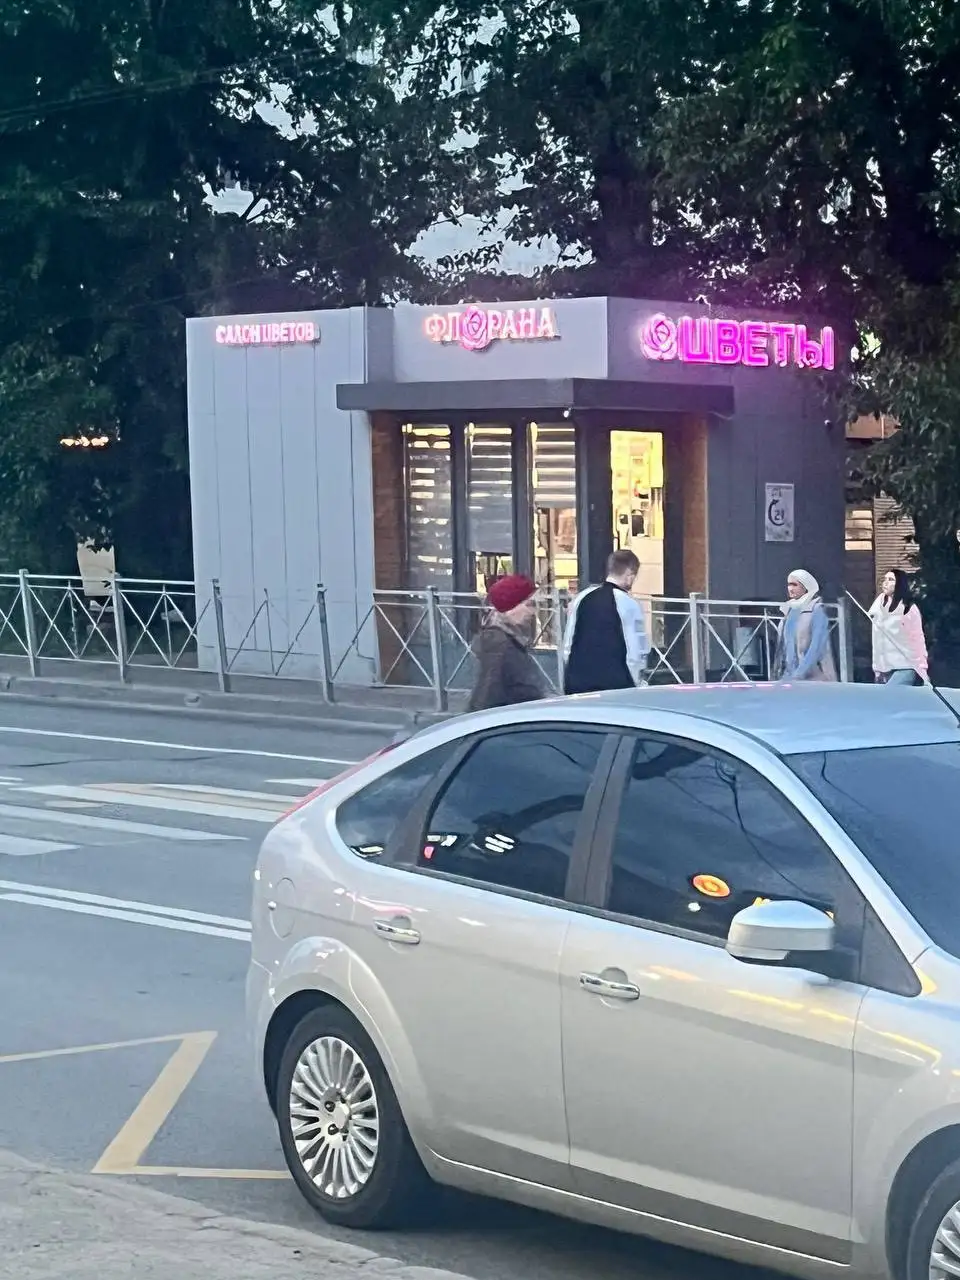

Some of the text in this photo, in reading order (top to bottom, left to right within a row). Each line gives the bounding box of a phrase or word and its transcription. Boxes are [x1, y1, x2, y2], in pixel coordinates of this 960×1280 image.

[216, 322, 317, 344] САЛОН ЦВЕТОВ
[677, 315, 836, 371] ЦВЕТЫ
